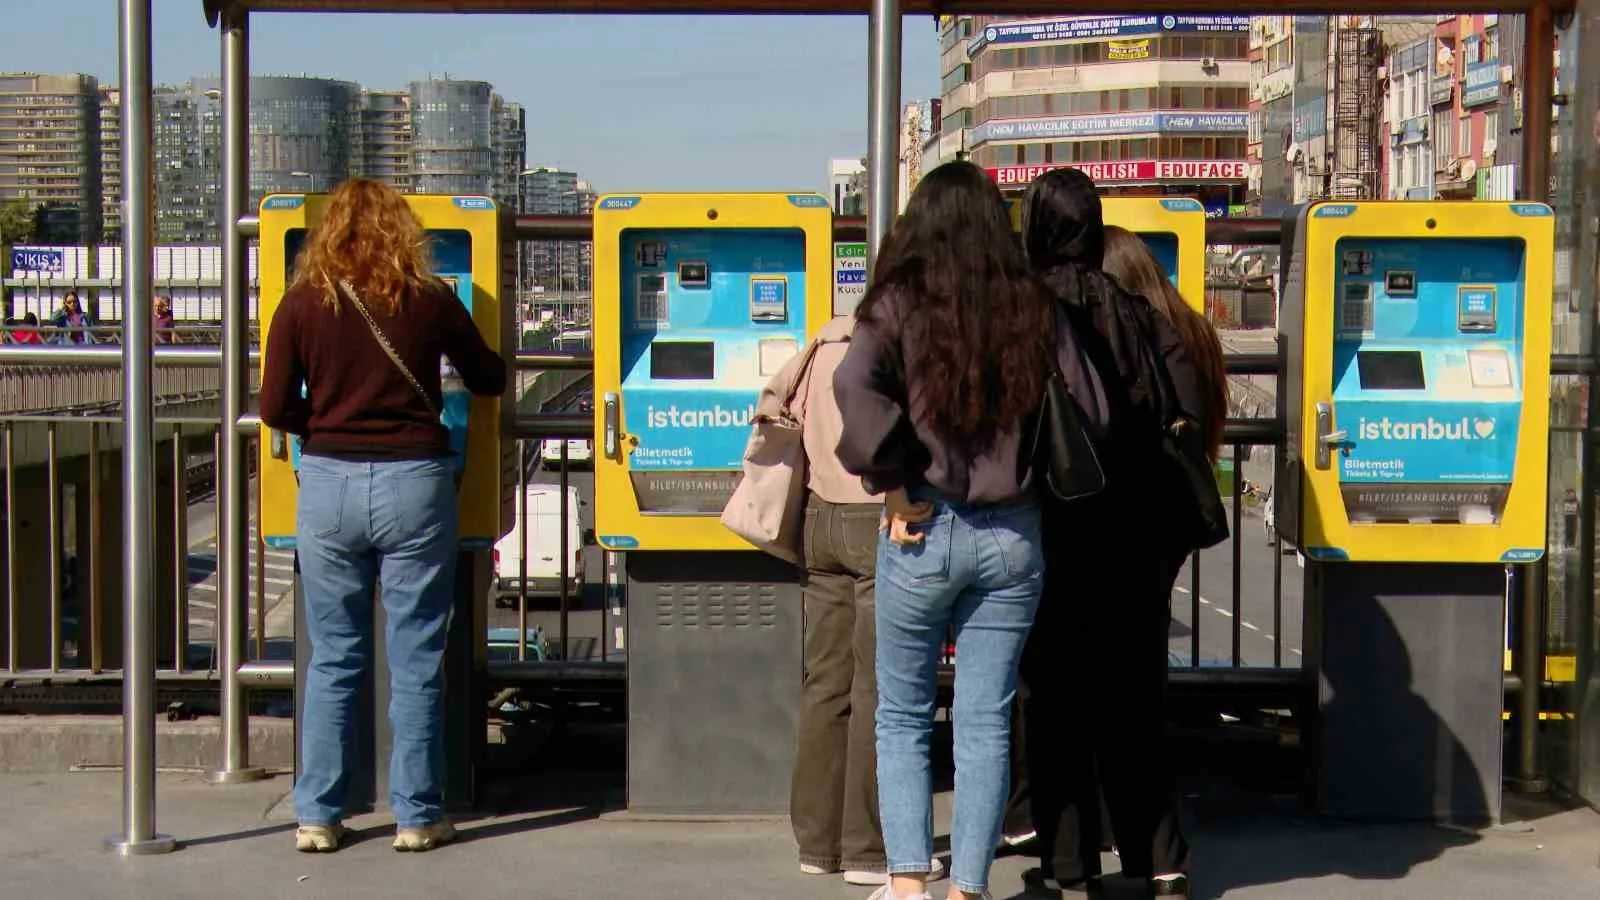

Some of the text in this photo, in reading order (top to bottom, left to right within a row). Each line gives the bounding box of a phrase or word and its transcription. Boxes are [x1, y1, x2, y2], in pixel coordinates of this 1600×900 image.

[1018, 118, 1069, 133] HAVACILIK
[1198, 114, 1243, 126] HAVACILIK
[997, 161, 1138, 184] EDUFA NGLISH
[1161, 163, 1244, 178] EDUFACE
[647, 404, 755, 428] istanbul
[1359, 416, 1471, 440] istanbul
[635, 447, 693, 457] Biletmatik
[1344, 459, 1405, 469] Biletmatik
